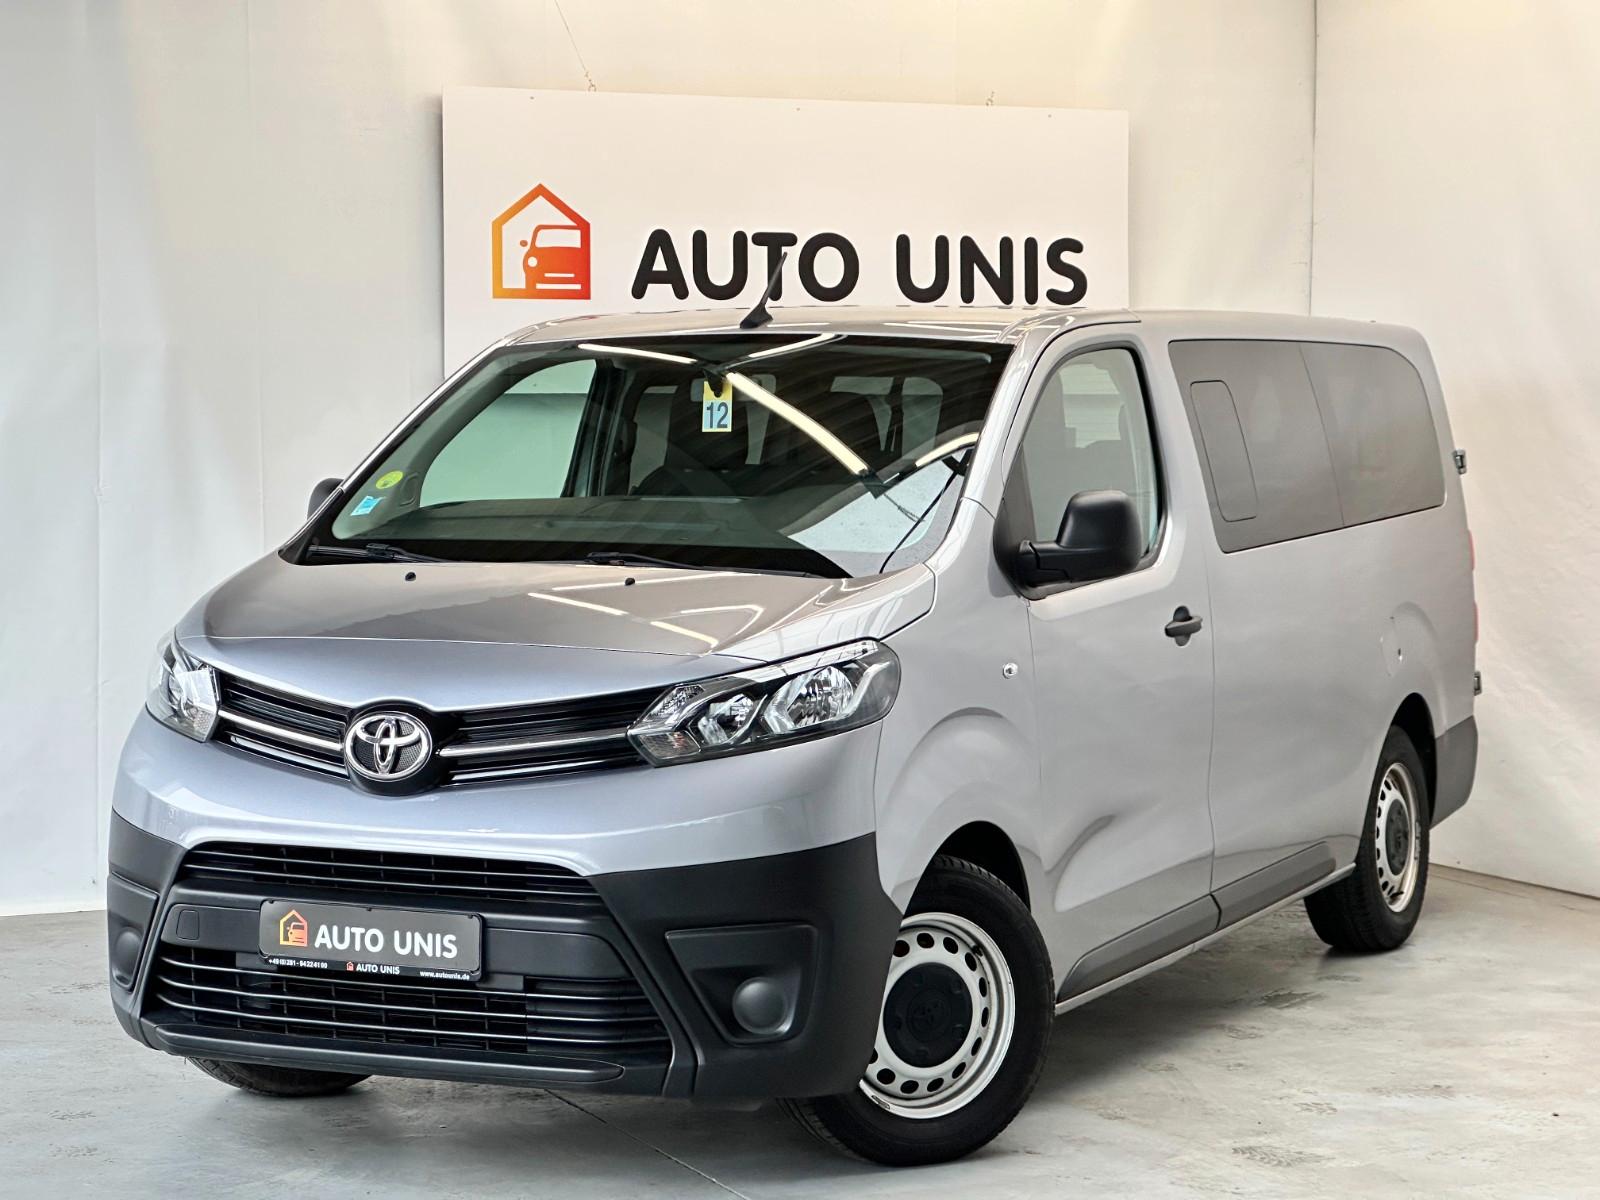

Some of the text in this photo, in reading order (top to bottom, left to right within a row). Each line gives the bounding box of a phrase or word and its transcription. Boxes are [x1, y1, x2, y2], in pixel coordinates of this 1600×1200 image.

[631, 228, 1088, 306] AUTO UNIS
[706, 401, 729, 429] 12
[314, 924, 458, 958] AUTO UNIS
[355, 963, 400, 975] AUTO UNIS
[419, 971, 470, 980] www.autounis.de
